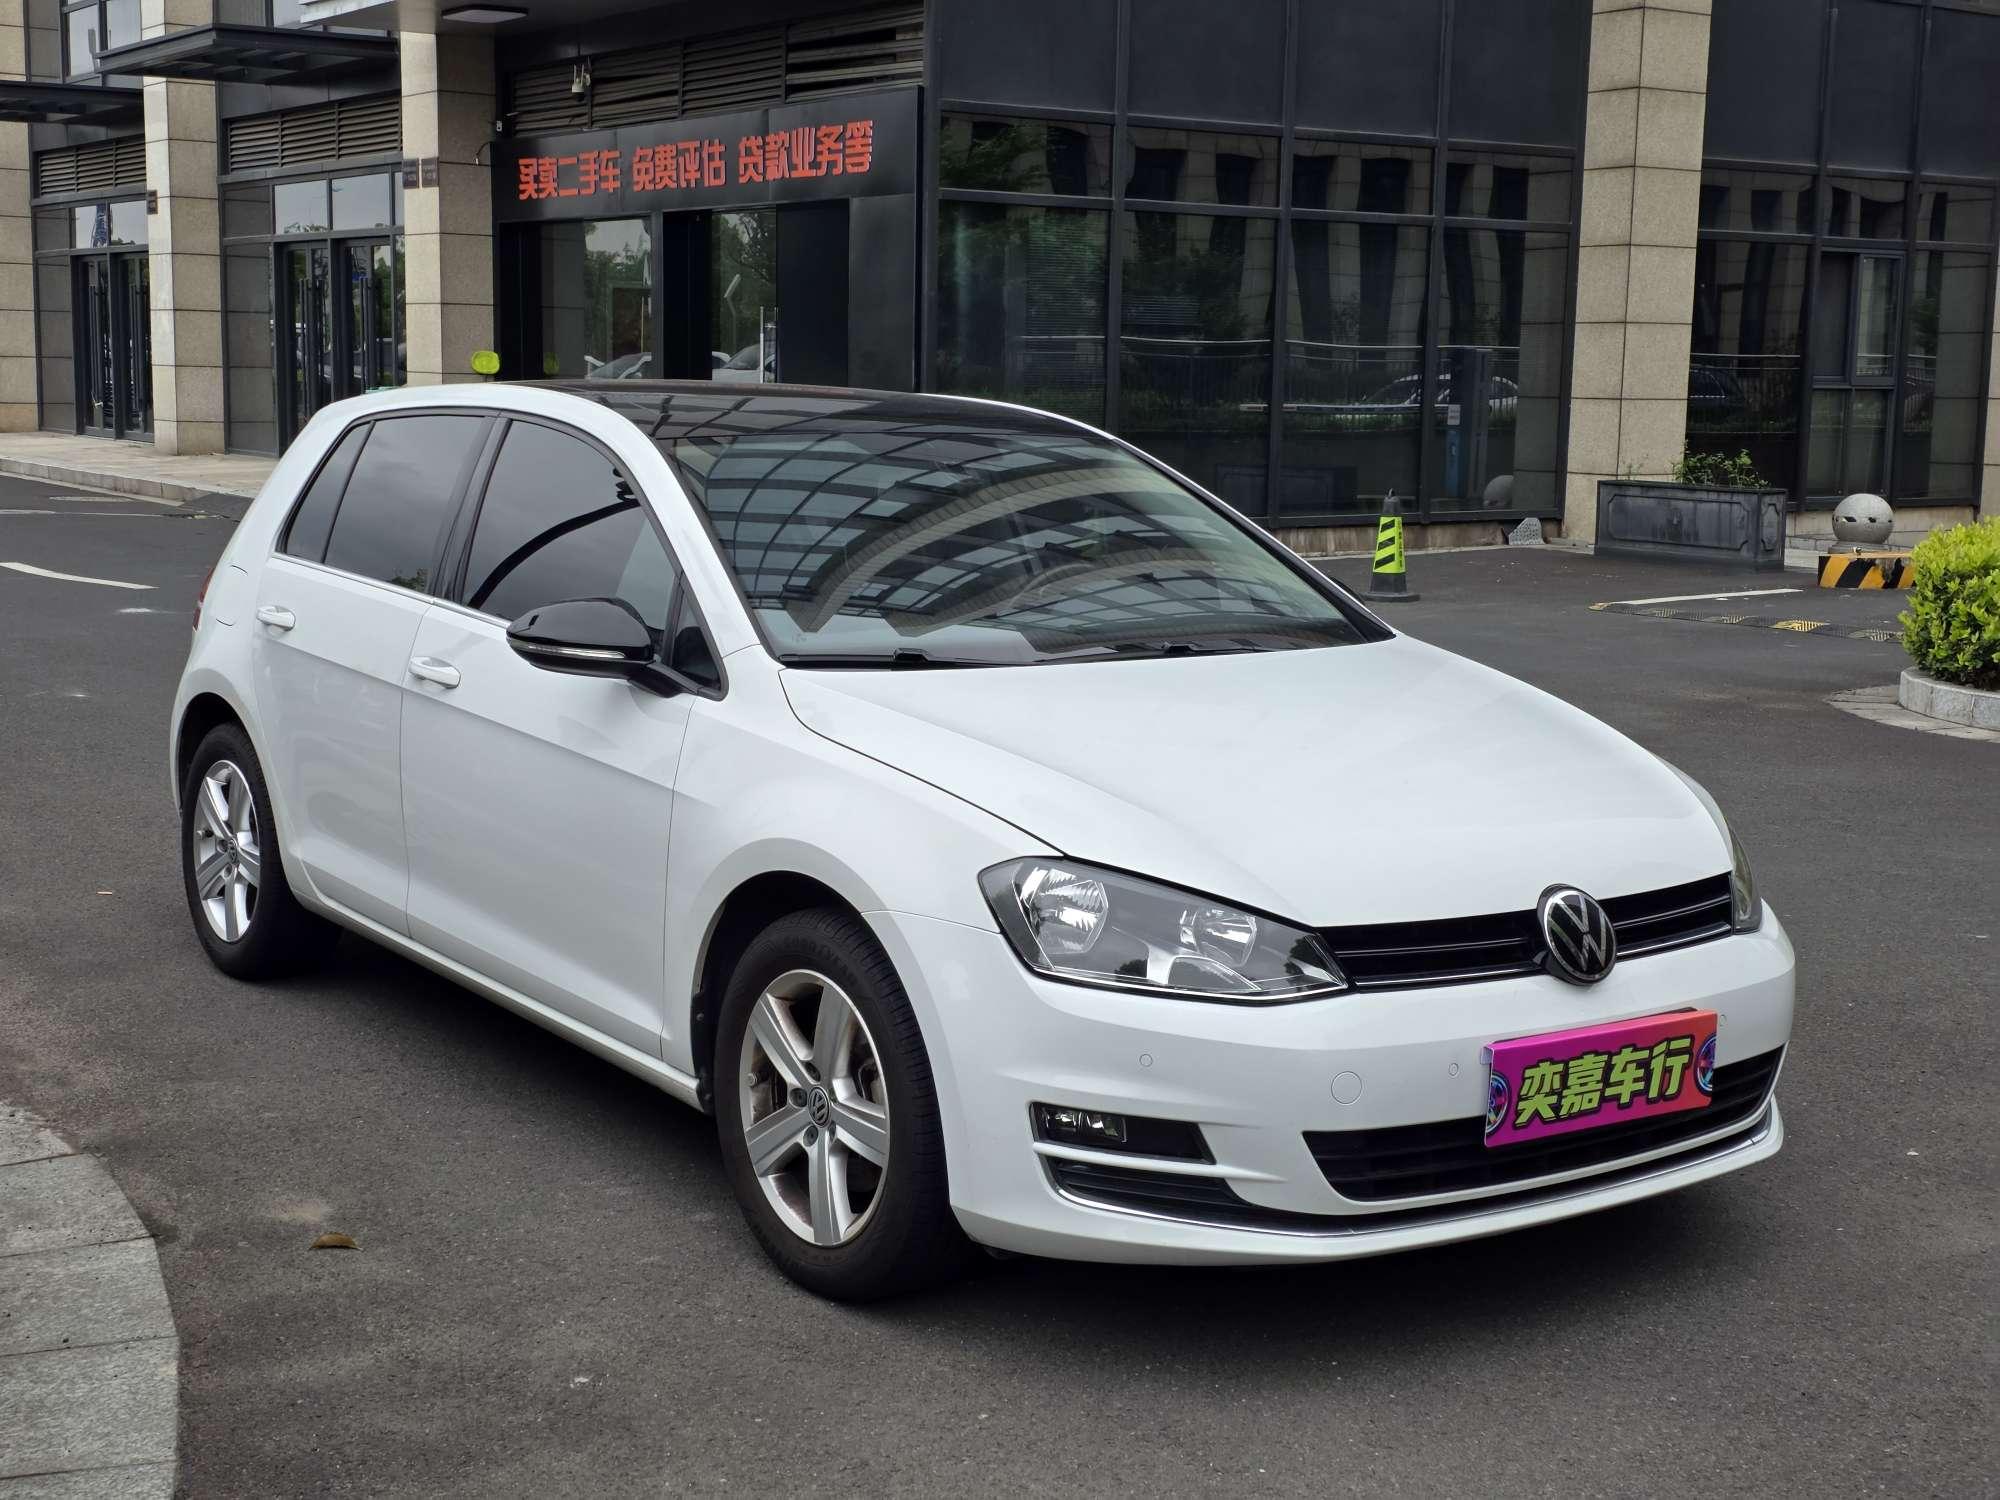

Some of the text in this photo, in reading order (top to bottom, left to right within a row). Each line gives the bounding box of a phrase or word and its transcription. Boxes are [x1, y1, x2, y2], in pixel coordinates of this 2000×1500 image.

[518, 119, 873, 200] 买卖二手车 免费评估 贷款业务等
[1515, 1037, 1692, 1126] 奕嘉车行
